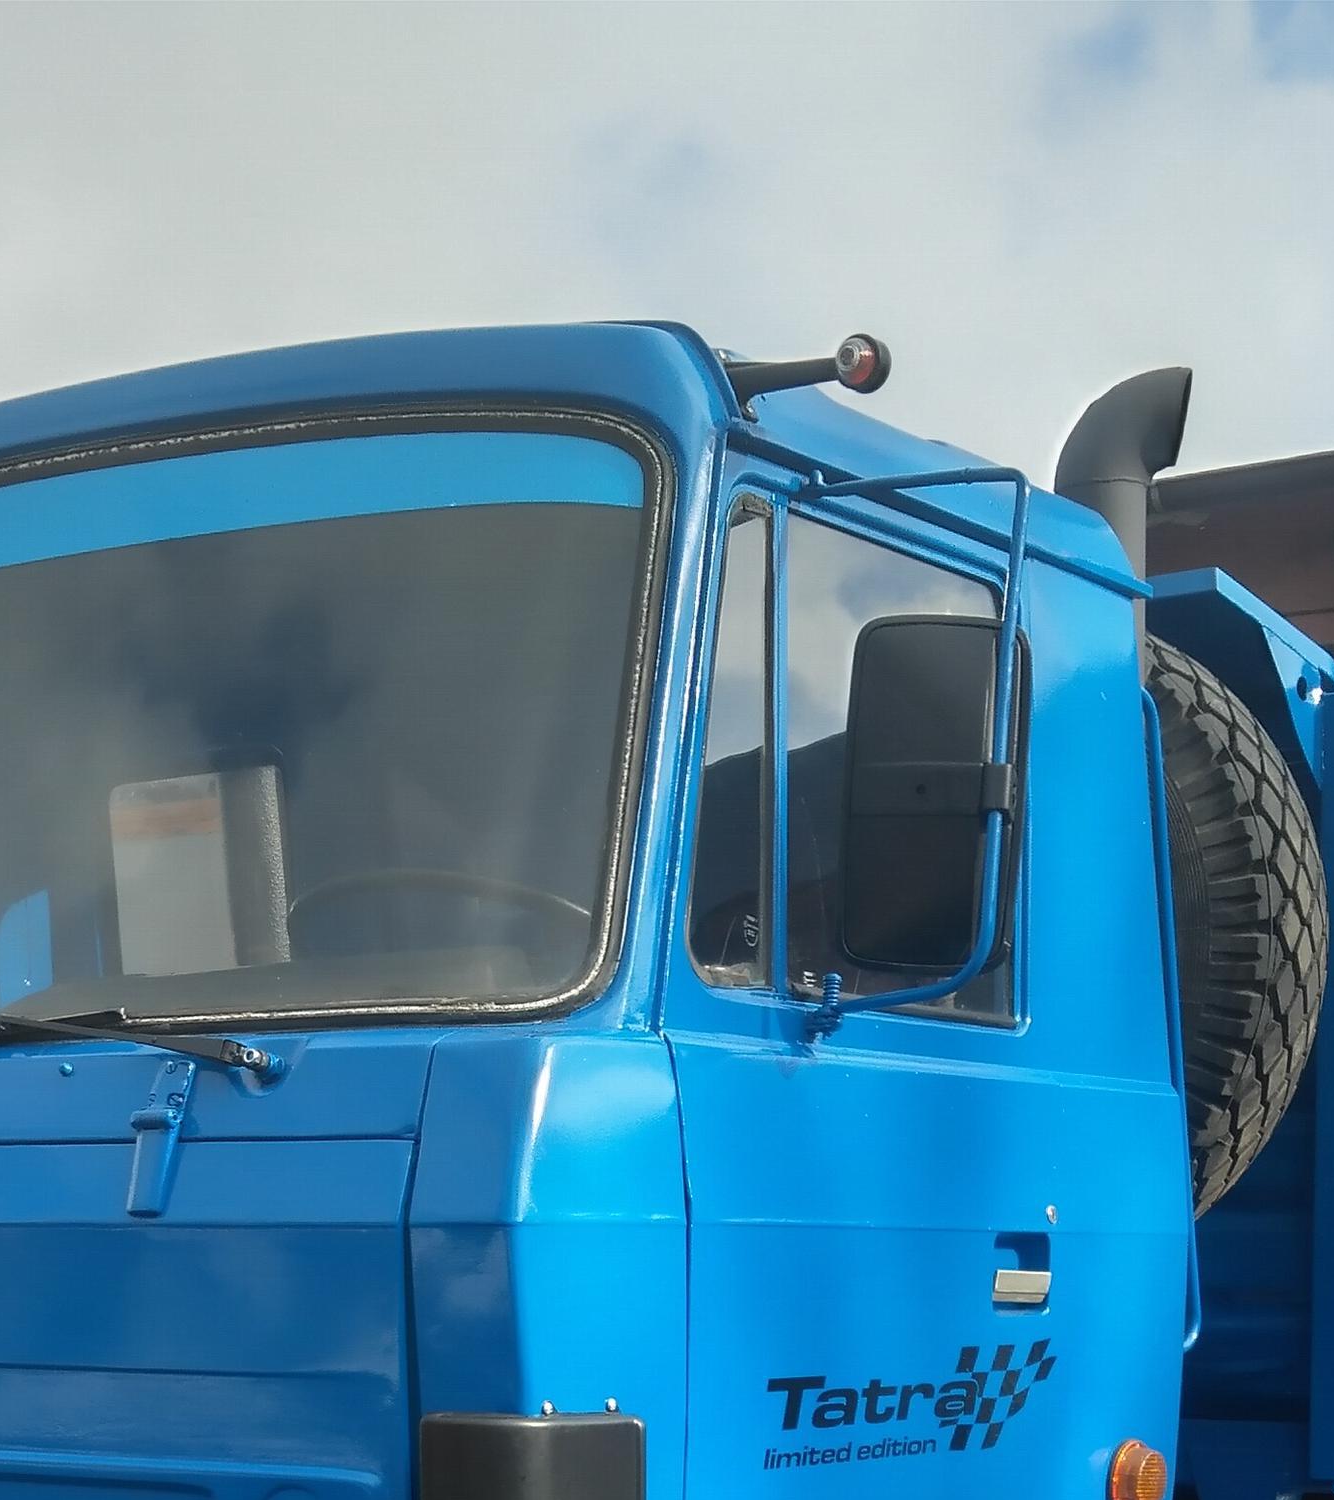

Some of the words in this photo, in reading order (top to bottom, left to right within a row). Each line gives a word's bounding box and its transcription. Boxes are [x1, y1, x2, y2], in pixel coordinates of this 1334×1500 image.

[766, 1375, 979, 1431] Tatra
[763, 1441, 852, 1470] limited
[856, 1436, 937, 1461] edition
